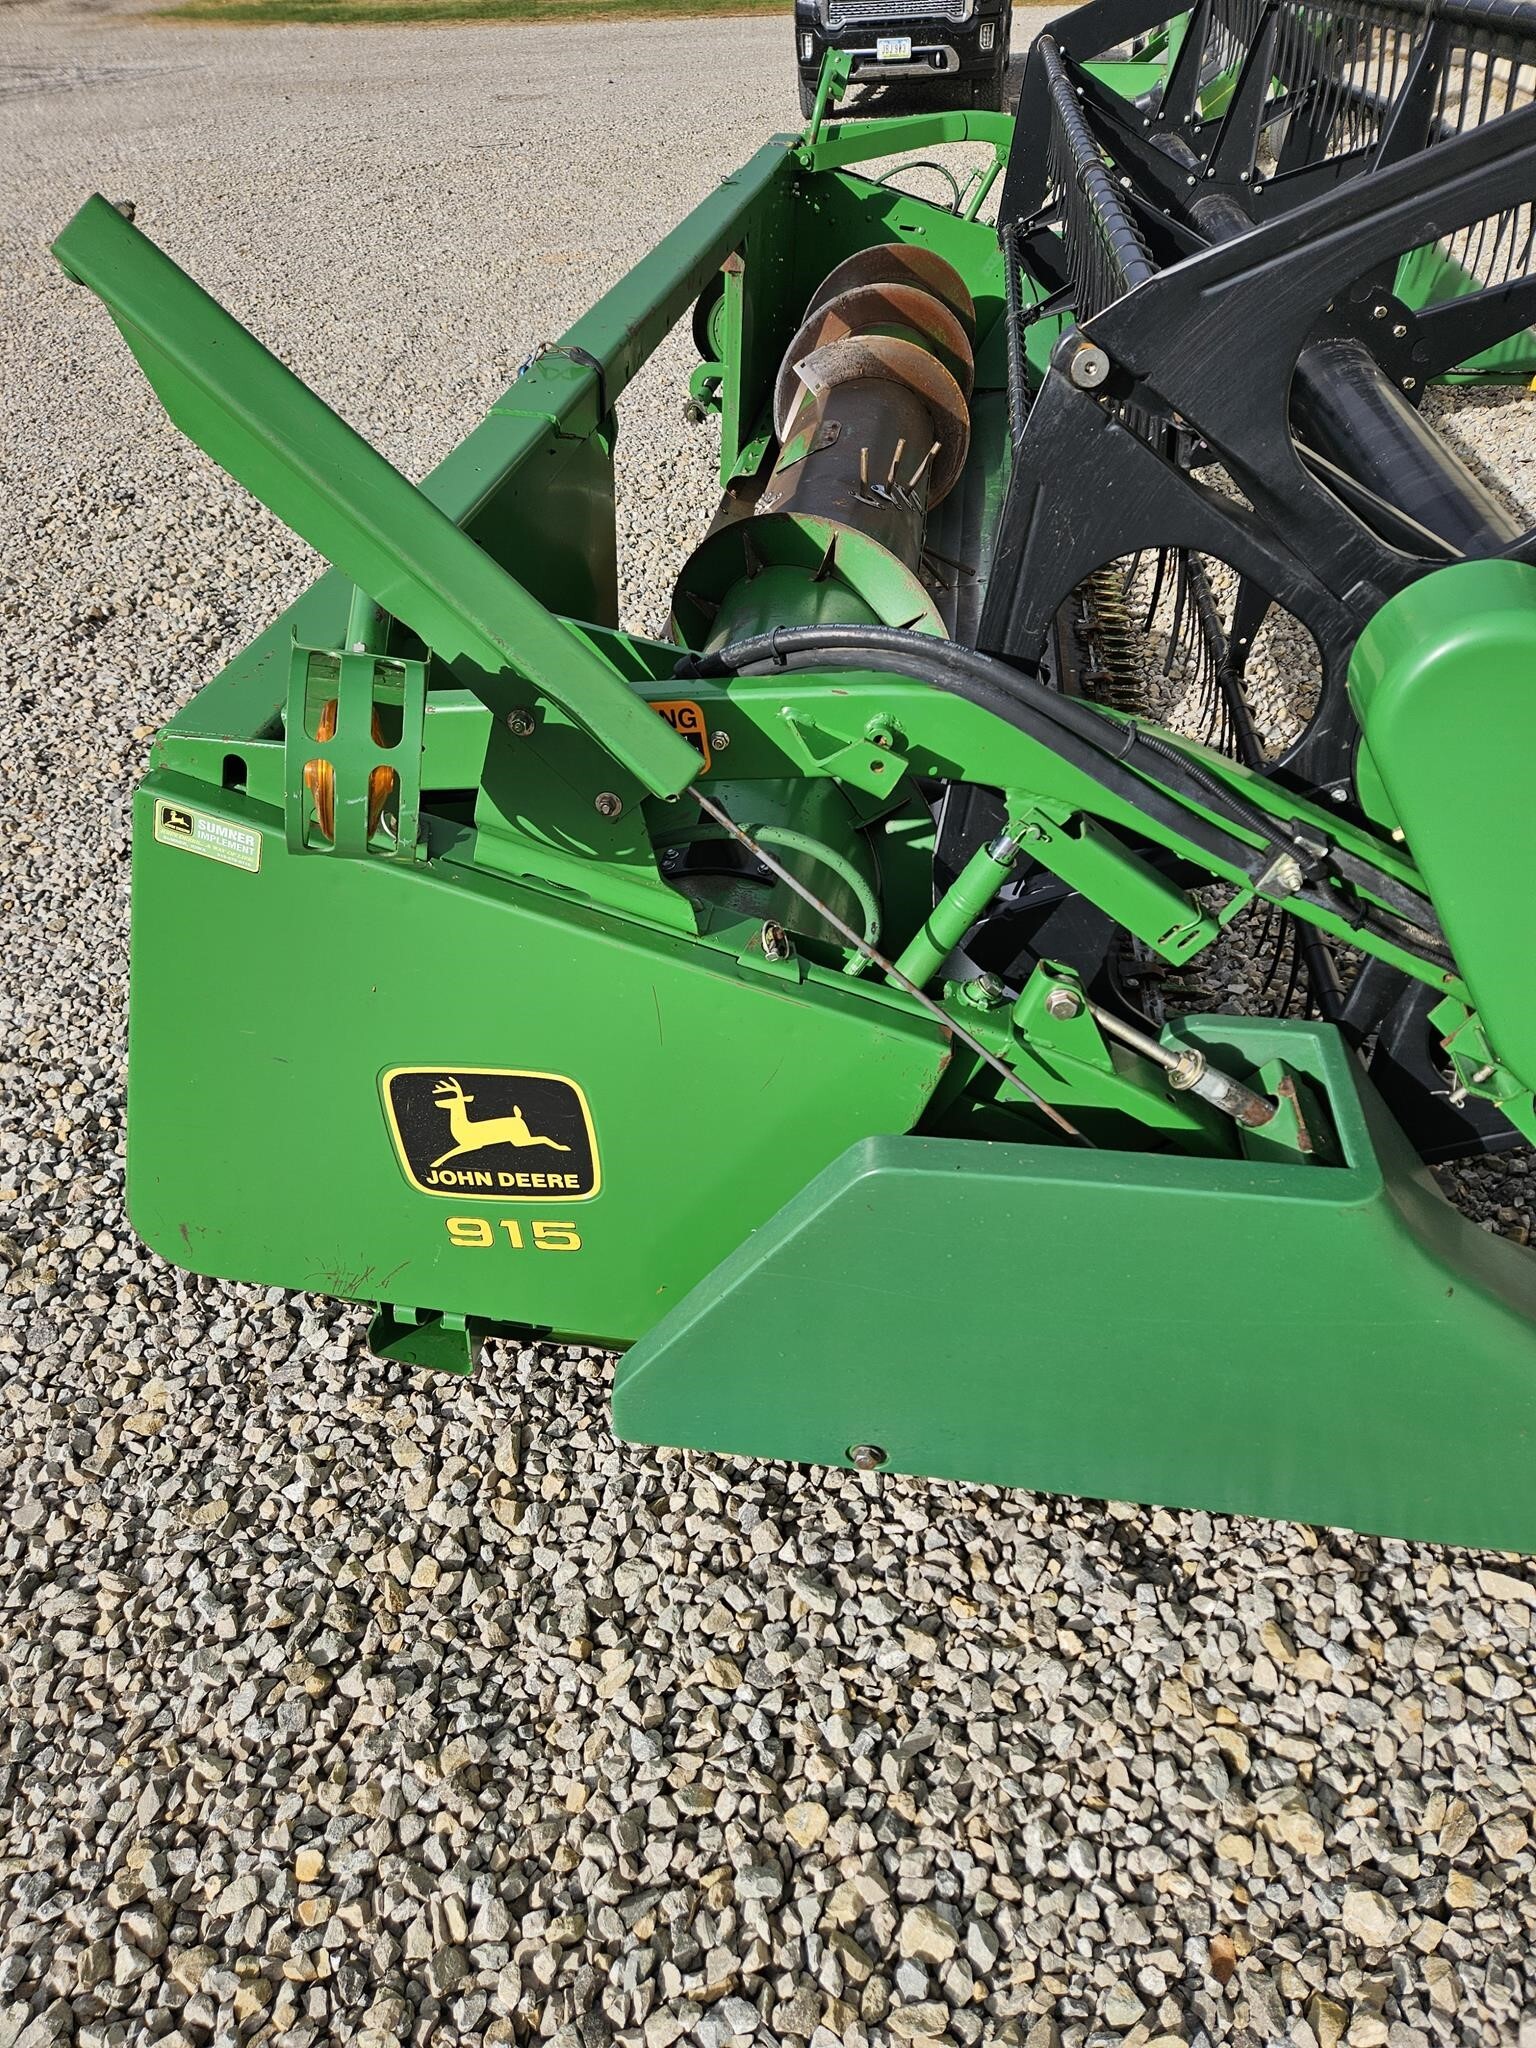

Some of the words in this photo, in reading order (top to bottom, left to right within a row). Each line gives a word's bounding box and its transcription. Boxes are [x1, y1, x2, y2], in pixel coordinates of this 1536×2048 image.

[197, 819, 255, 847] SUMNER
[197, 830, 255, 856] IMPLEMENT
[426, 1169, 493, 1187] JOHN
[497, 1172, 580, 1189] DEERE
[445, 1216, 583, 1252] 915
